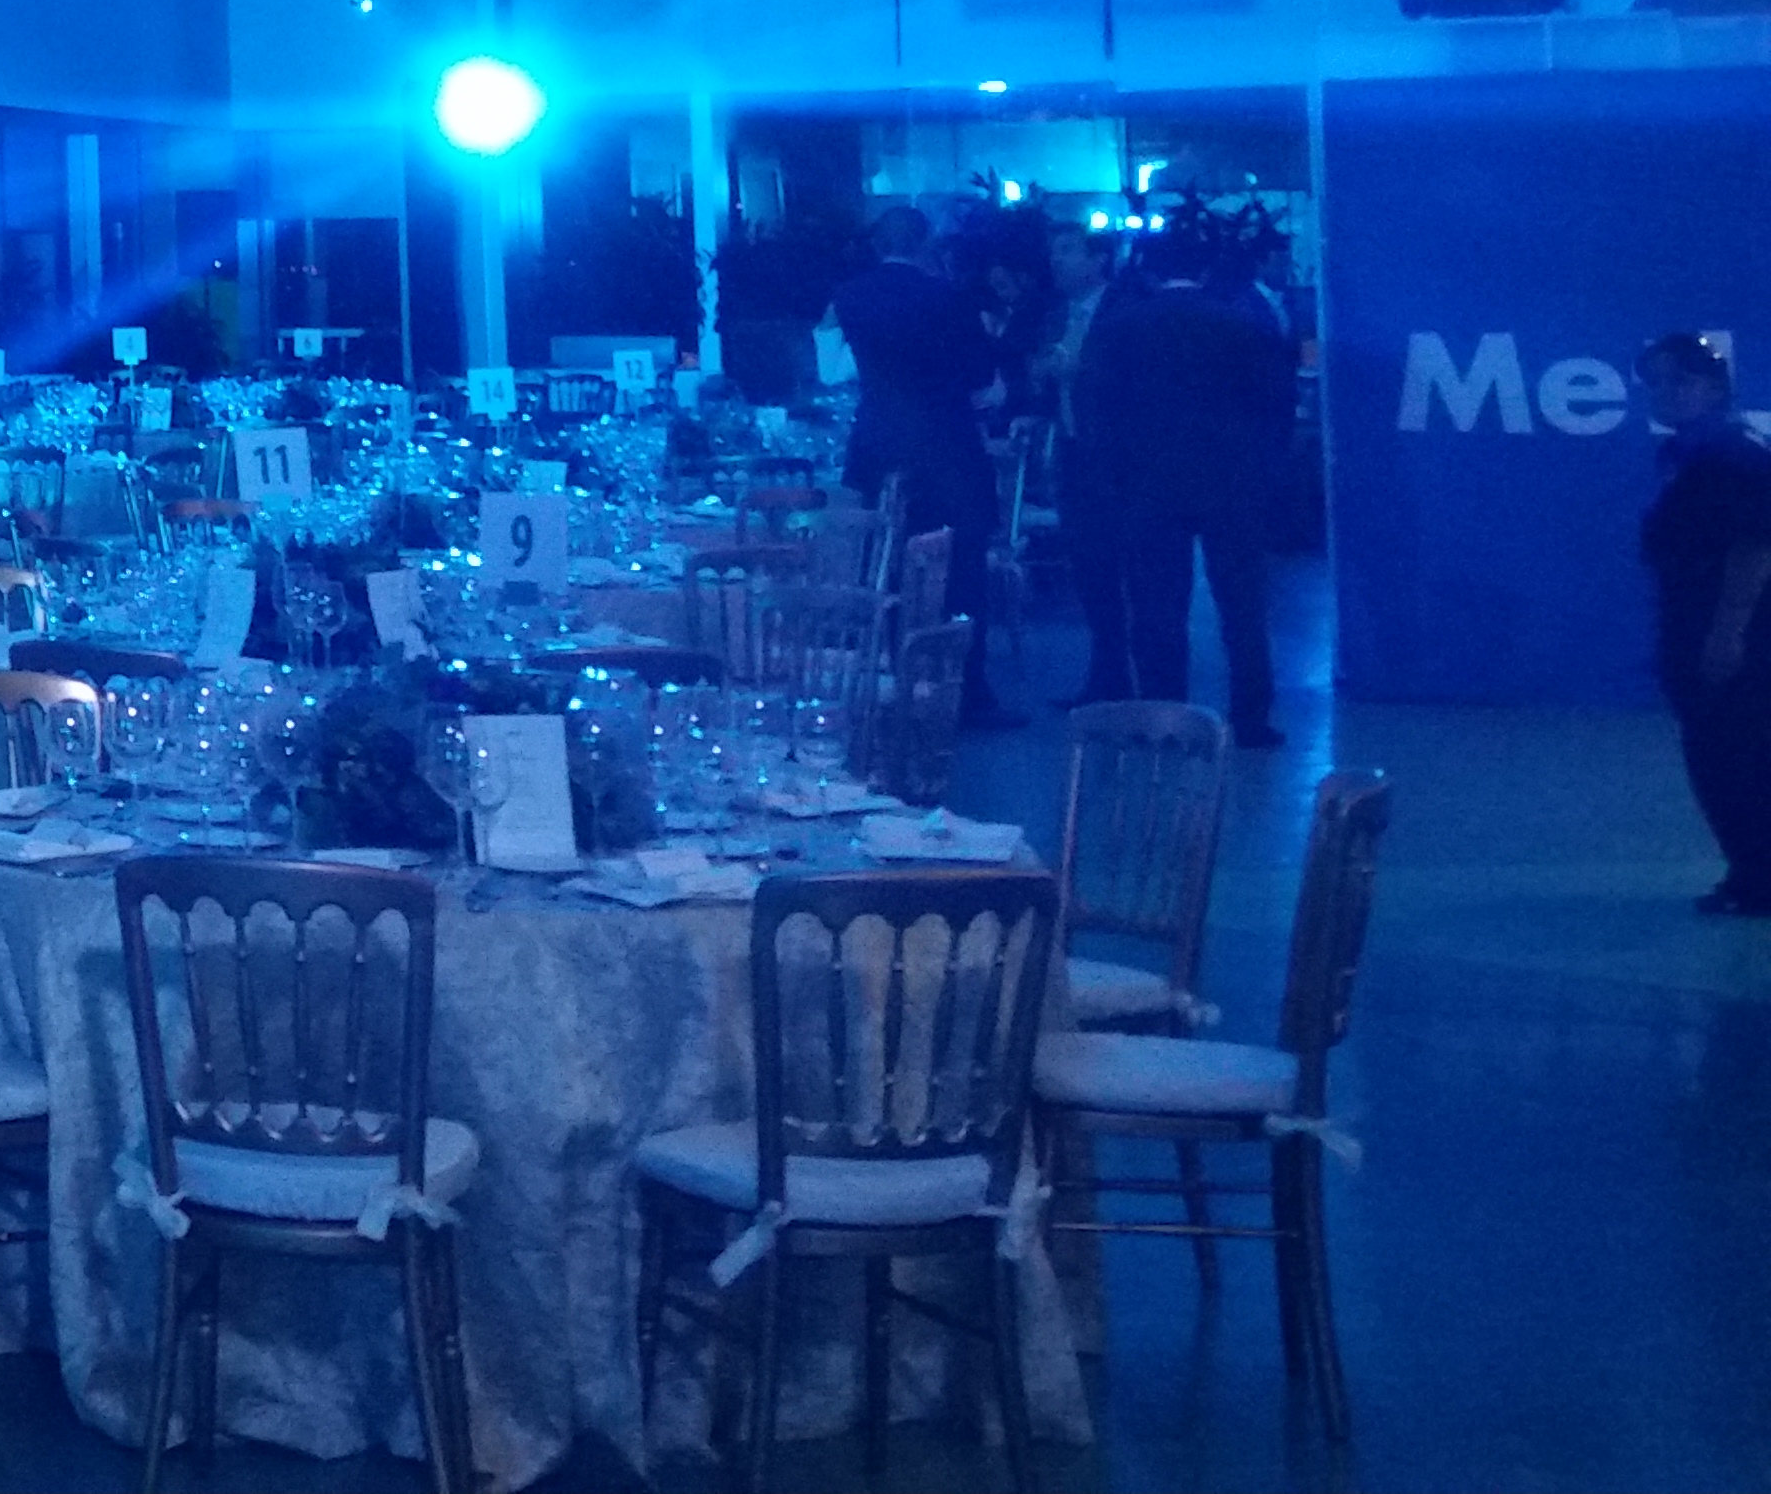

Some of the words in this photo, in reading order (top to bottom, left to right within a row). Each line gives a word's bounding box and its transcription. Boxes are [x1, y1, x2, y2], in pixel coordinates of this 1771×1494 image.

[482, 379, 505, 403] 14
[252, 443, 290, 486] 11
[510, 514, 534, 568] 9
